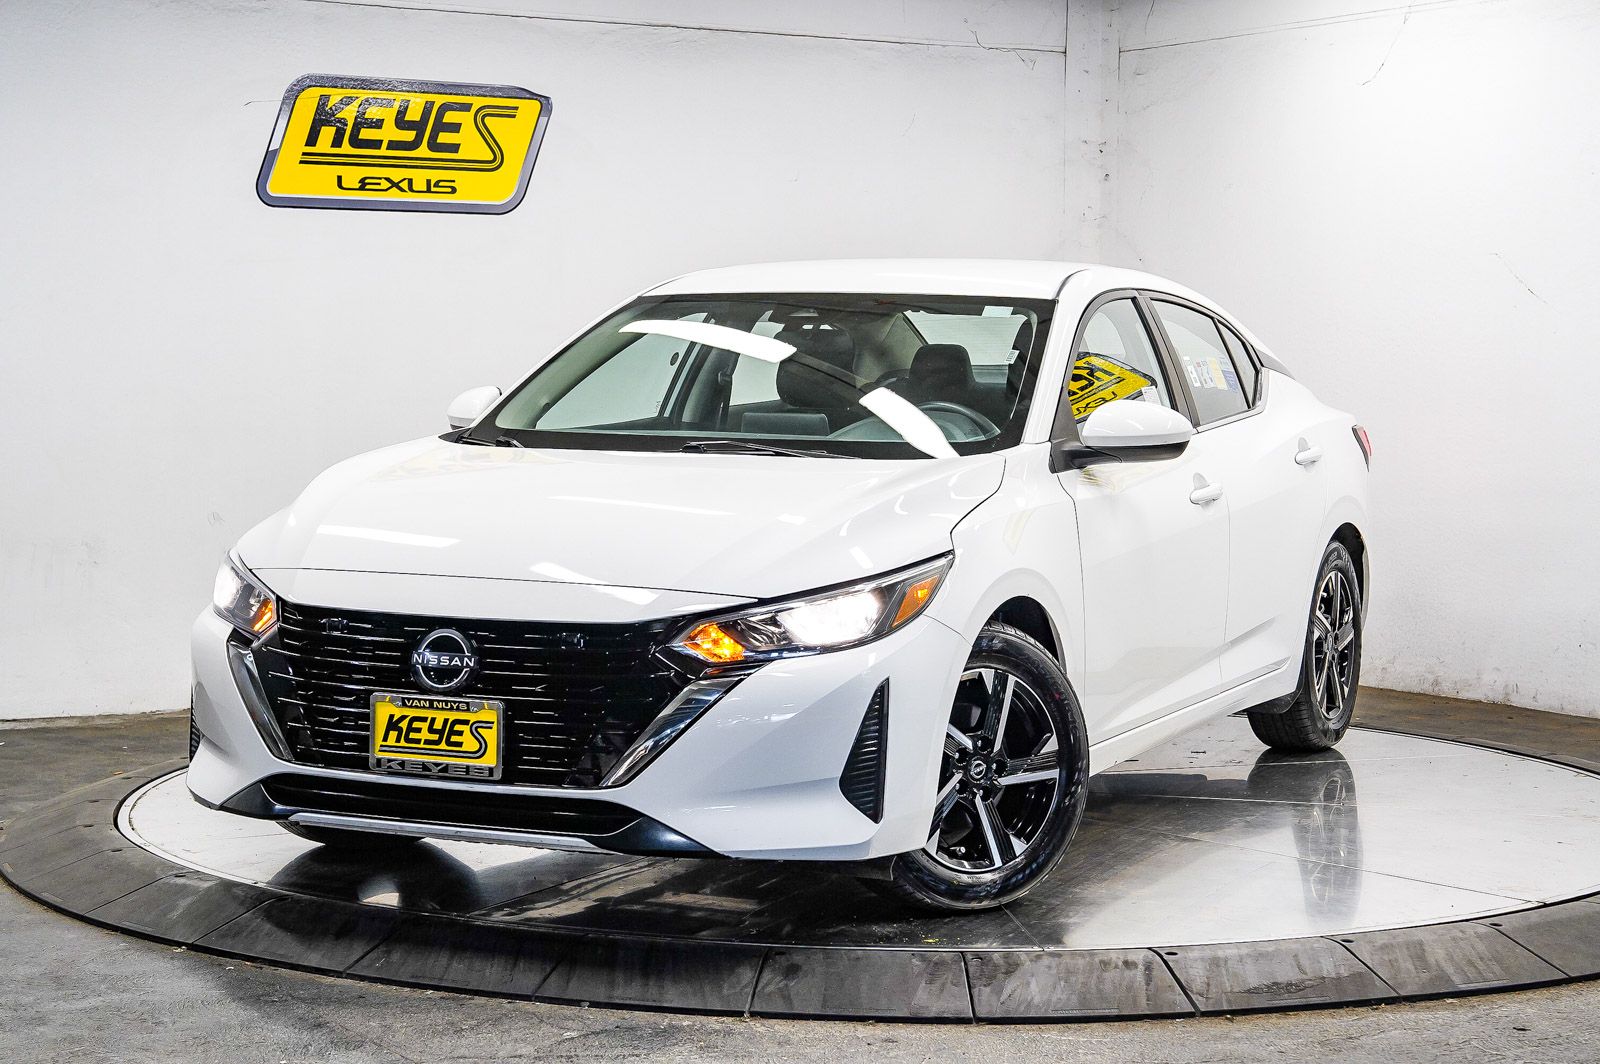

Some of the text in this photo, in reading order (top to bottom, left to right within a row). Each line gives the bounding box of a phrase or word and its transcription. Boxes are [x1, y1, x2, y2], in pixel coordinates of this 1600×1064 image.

[299, 94, 520, 172] KEYES
[336, 174, 457, 195] LEXUS
[413, 654, 475, 667] NISSAN
[404, 699, 468, 710] VAN NUYS
[378, 713, 495, 759] KEYES
